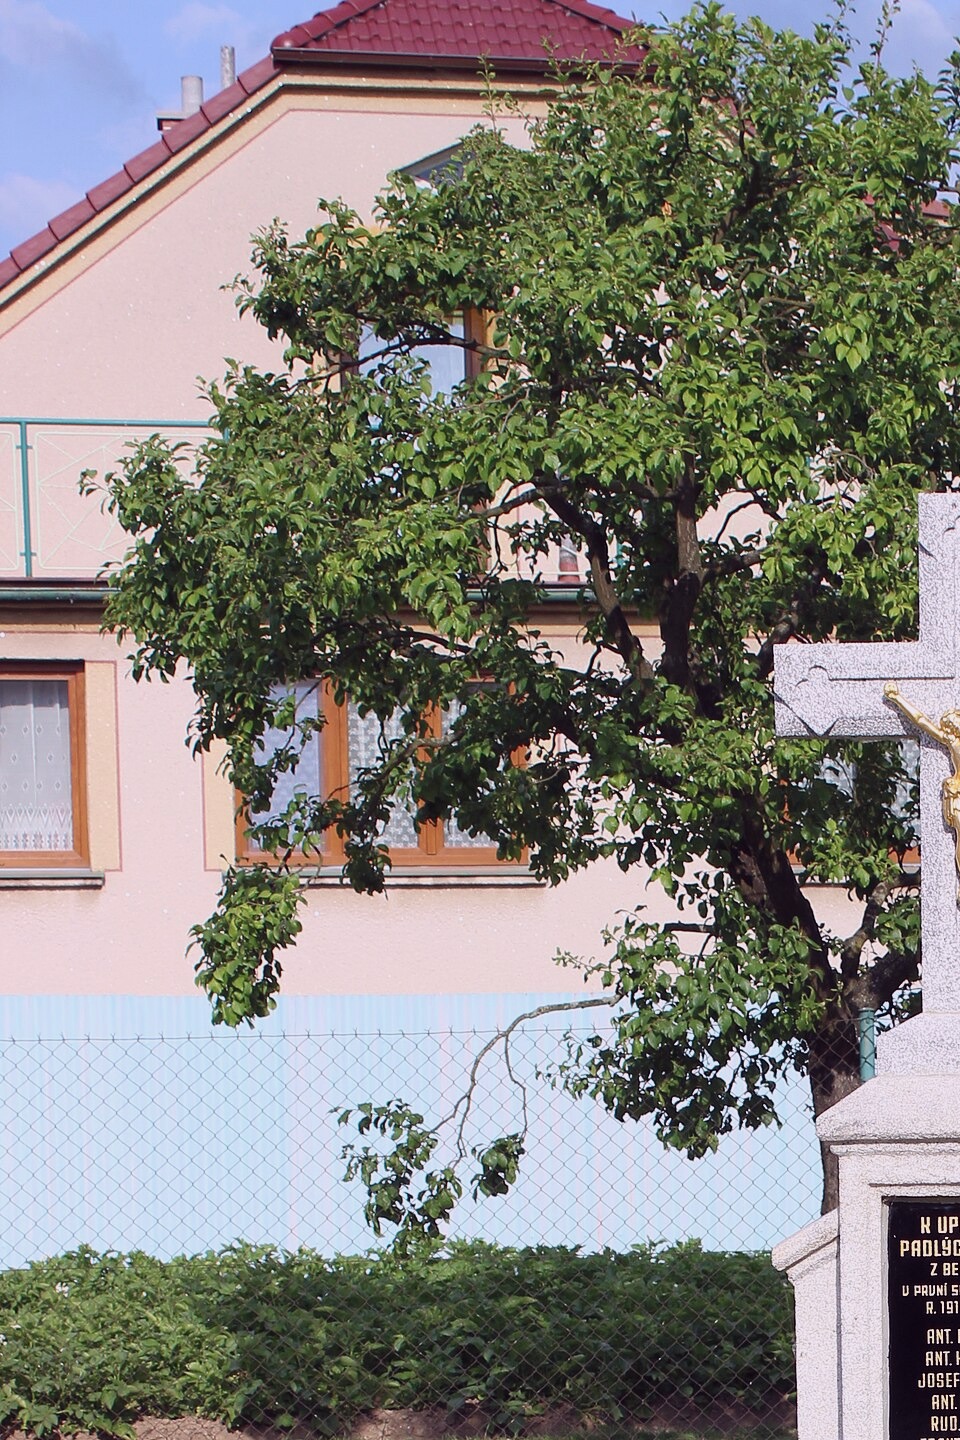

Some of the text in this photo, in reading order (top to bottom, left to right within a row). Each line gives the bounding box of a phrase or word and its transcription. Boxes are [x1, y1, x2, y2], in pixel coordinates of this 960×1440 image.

[921, 1217, 930, 1233] K
[930, 1263, 937, 1276] Z
[902, 1285, 909, 1296] V
[914, 1283, 947, 1296] PRVNÍ
[926, 1301, 936, 1314] R.
[927, 1329, 953, 1344] ANT.
[926, 1351, 952, 1366] ANT.
[918, 1373, 960, 1388] JOSEF
[932, 1394, 957, 1410] ANT.
[931, 1416, 960, 1431] RUD.
